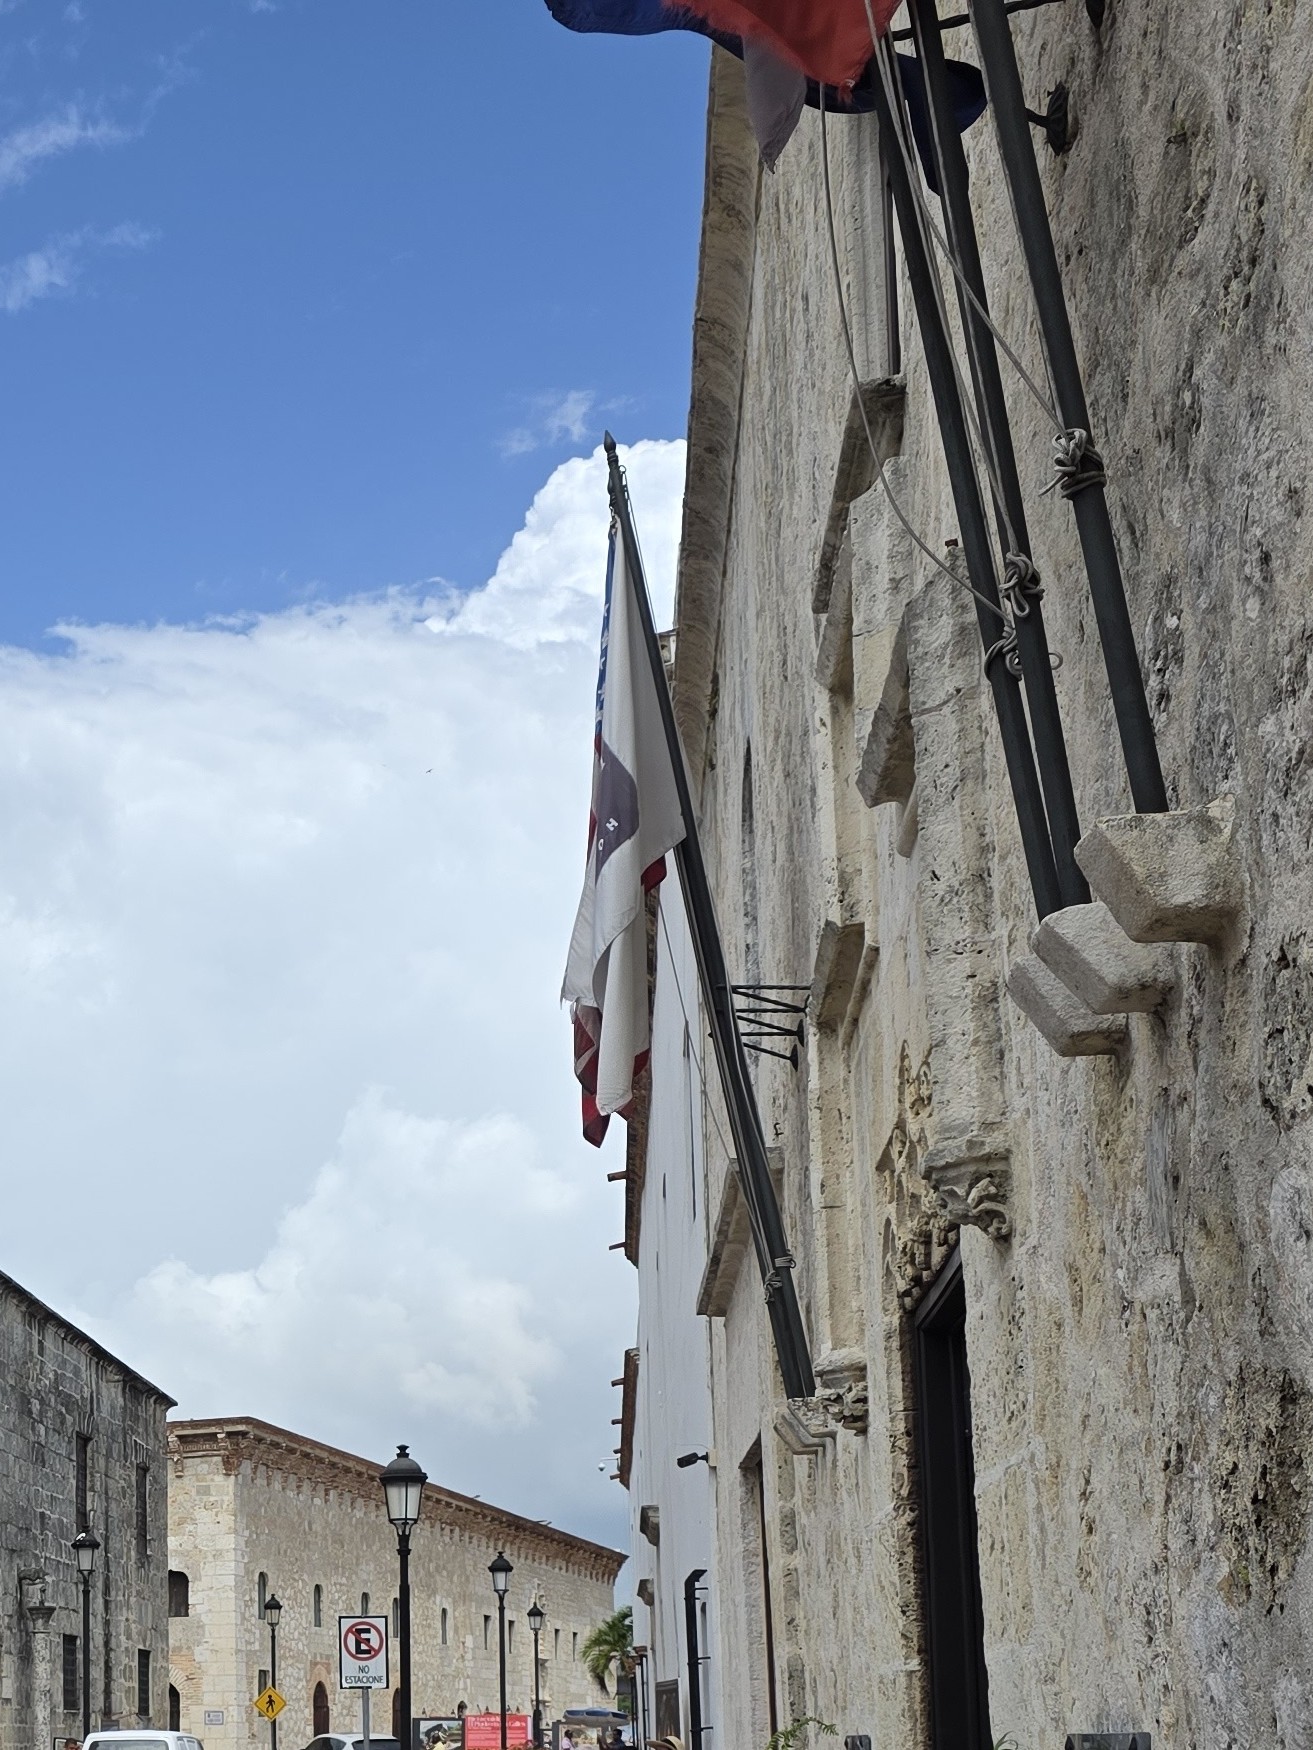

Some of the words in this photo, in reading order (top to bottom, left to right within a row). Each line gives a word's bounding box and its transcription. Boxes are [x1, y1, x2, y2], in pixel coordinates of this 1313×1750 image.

[355, 1628, 371, 1655] E
[358, 1665, 370, 1674] NO
[345, 1676, 384, 1684] ESTACIONE
